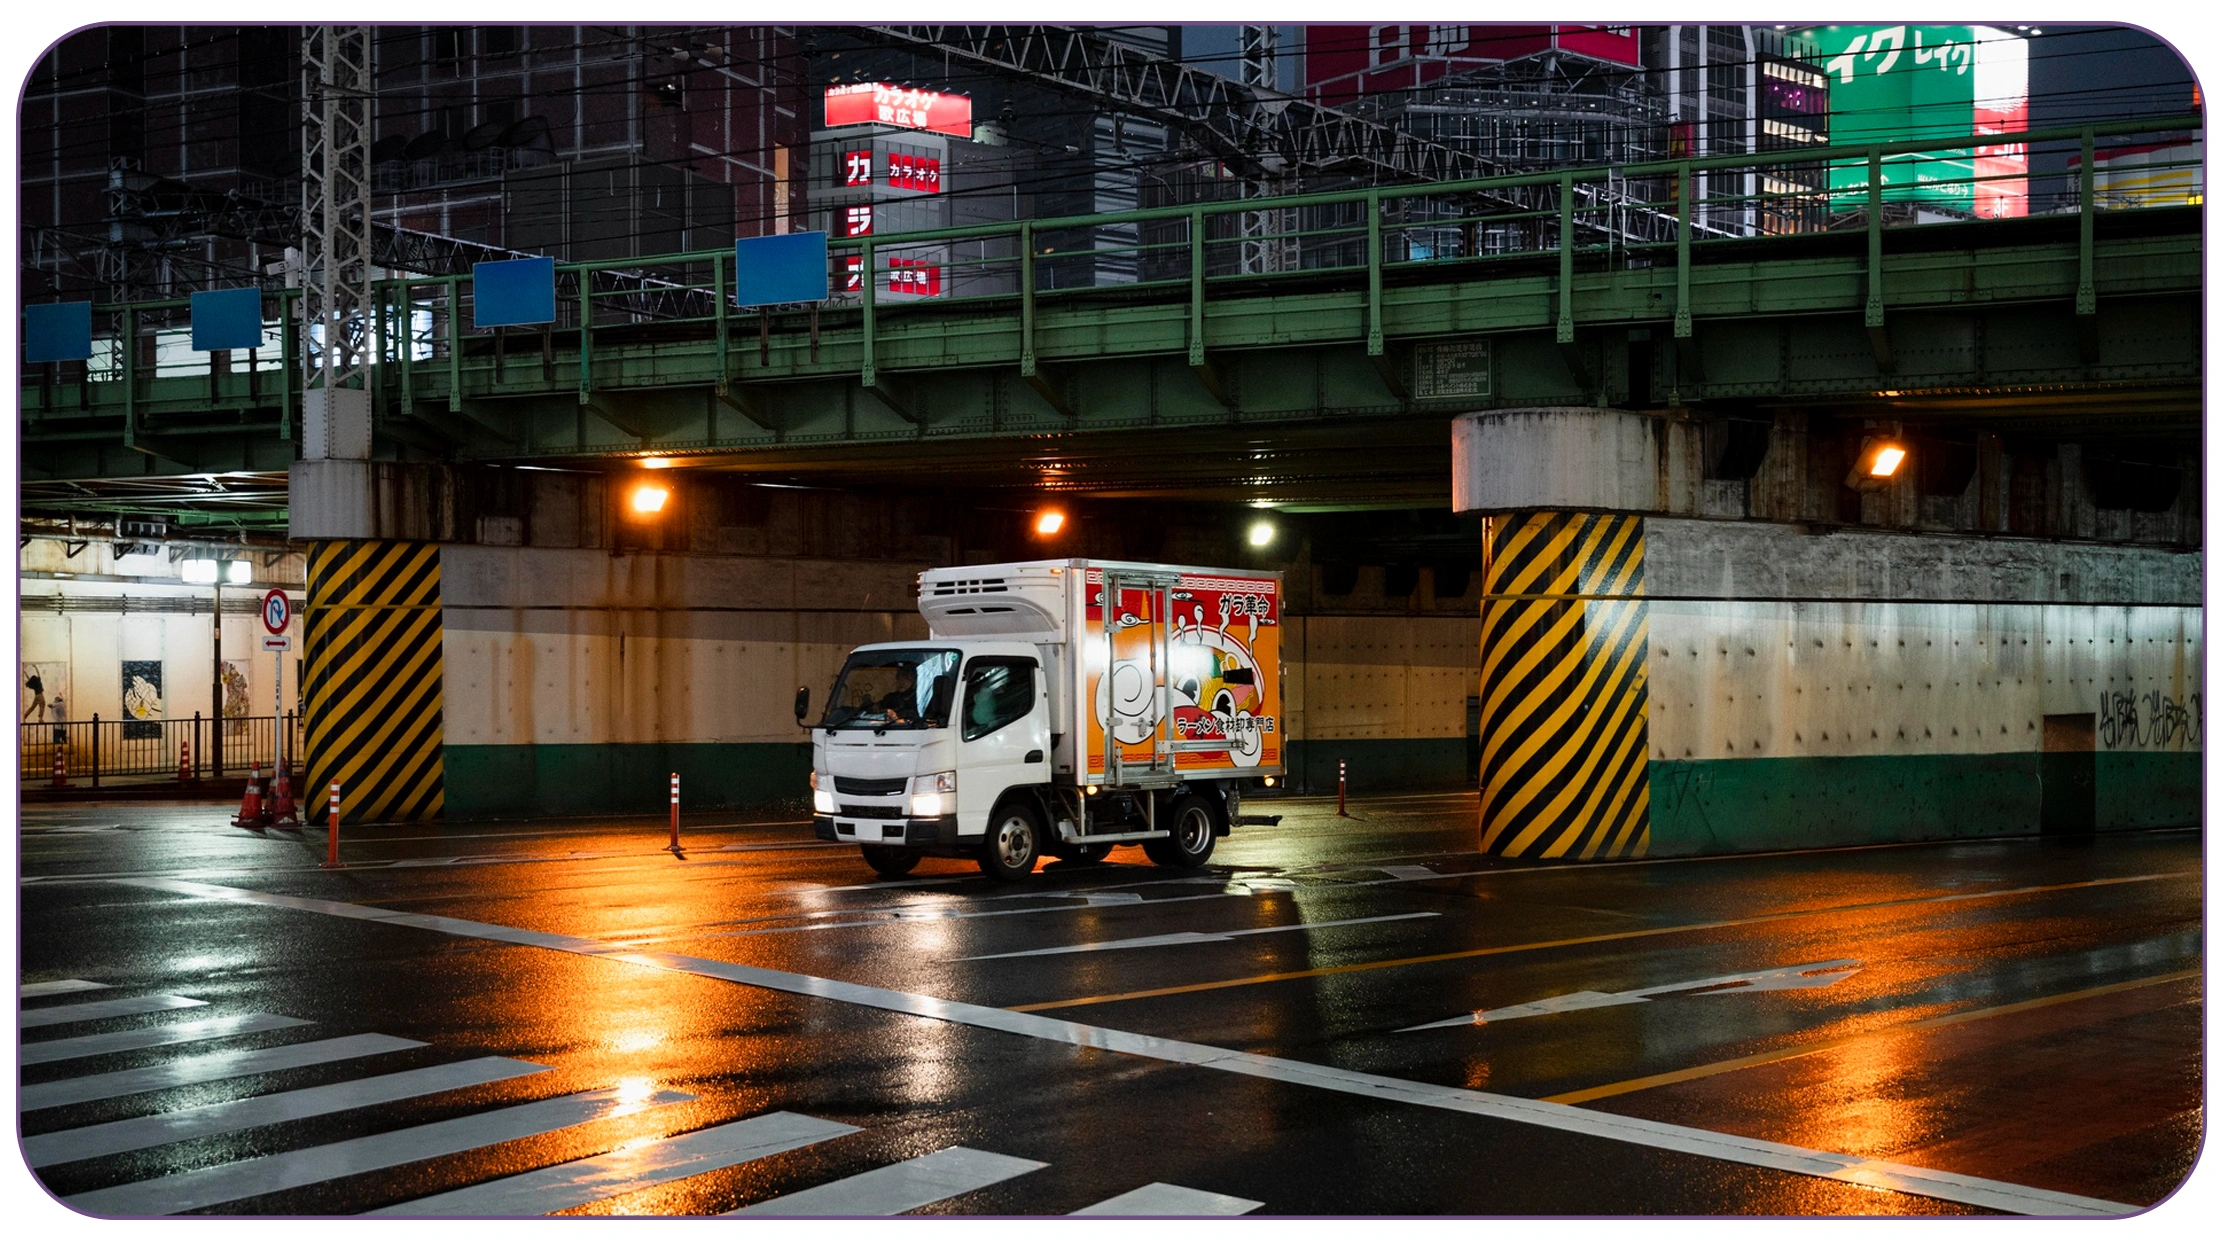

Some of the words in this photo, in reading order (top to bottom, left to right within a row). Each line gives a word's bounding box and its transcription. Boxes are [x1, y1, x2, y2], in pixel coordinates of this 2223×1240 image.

[1915, 29, 1971, 76] レイク
[874, 85, 938, 110] カラオケ
[878, 105, 928, 127] 歌広場
[890, 163, 940, 183] カラオケ
[1219, 593, 1271, 617] ガラ革命
[1177, 715, 1275, 736] ラーメン食材卸専門店
